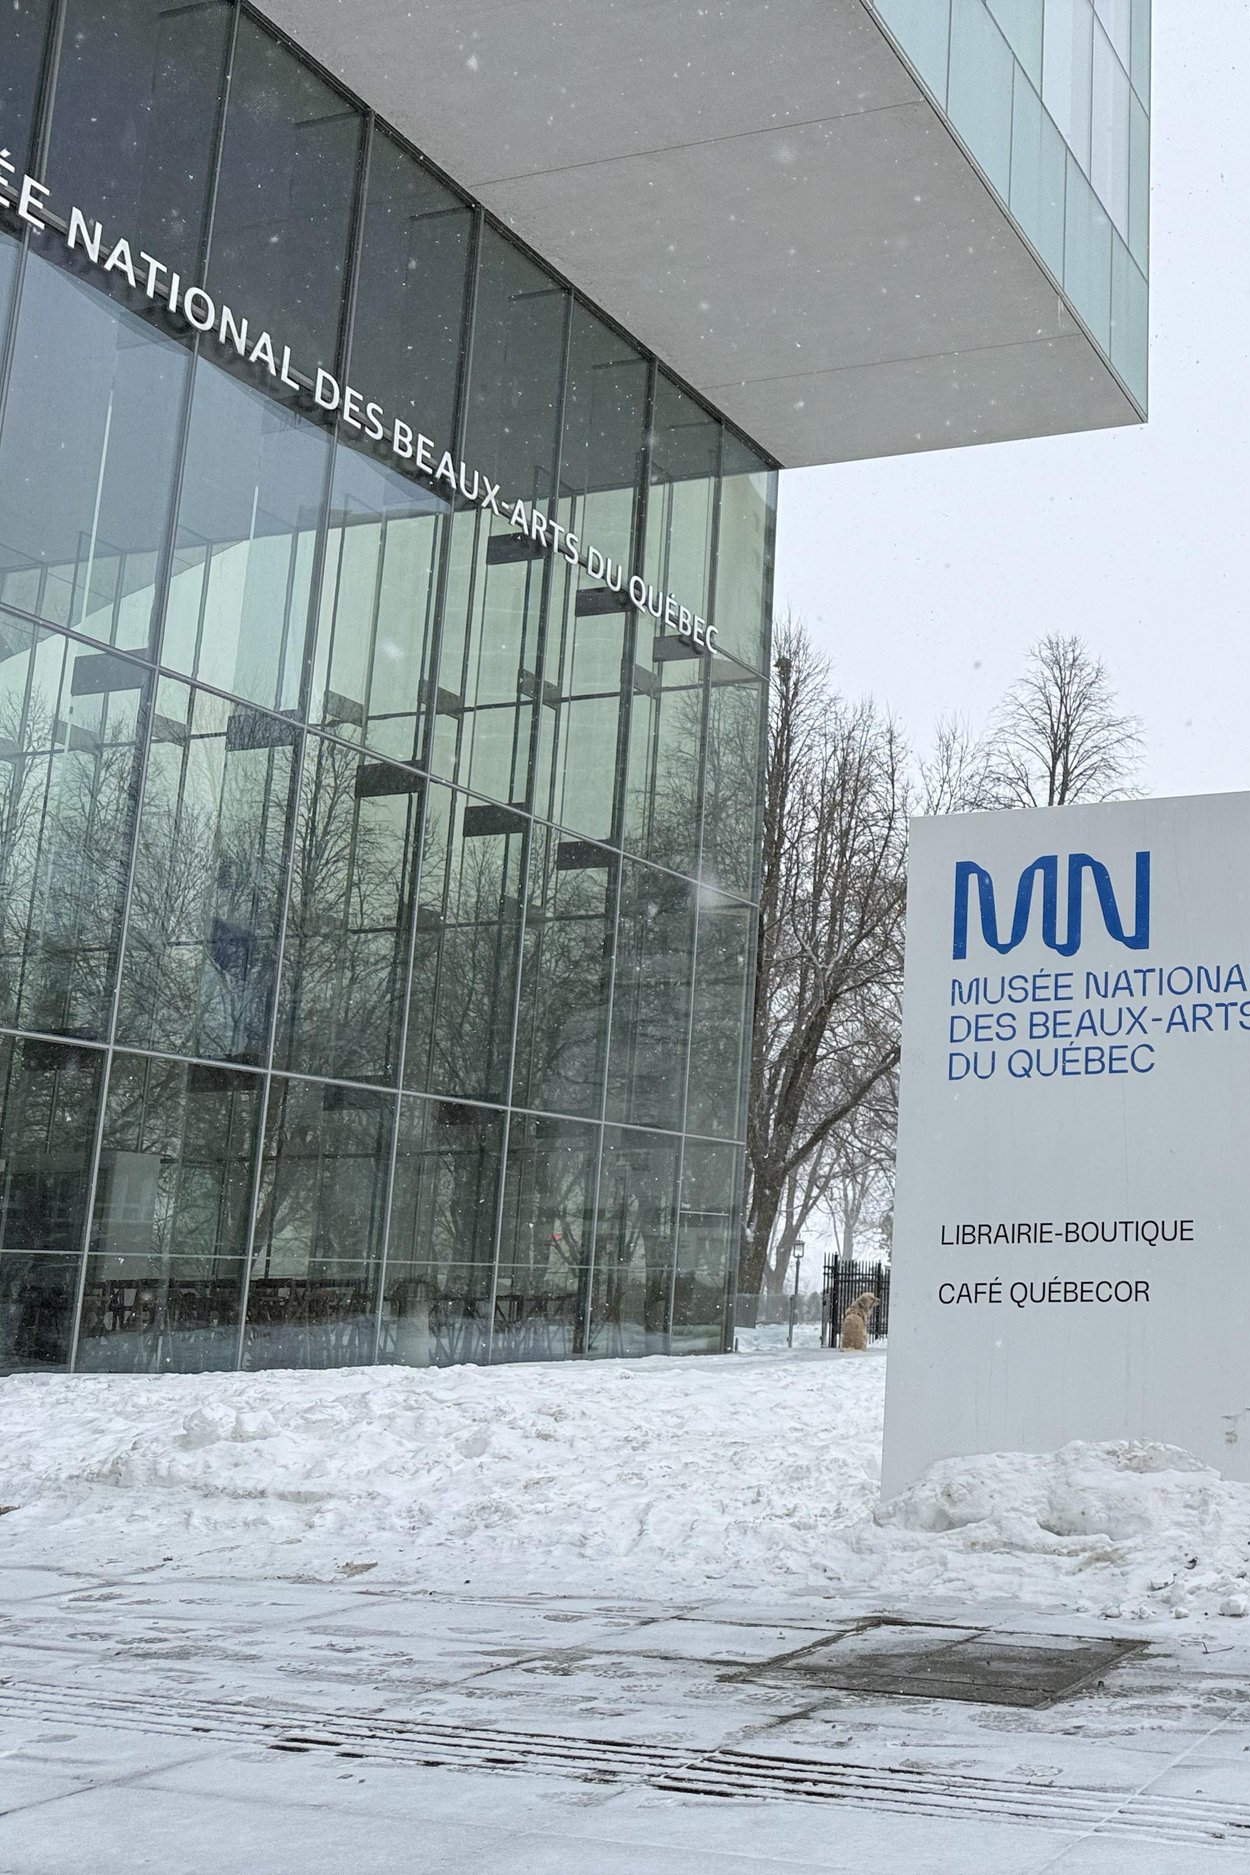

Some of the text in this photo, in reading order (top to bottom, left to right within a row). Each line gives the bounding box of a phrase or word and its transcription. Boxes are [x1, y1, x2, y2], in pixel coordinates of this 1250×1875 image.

[66, 206, 300, 391] NATIONAL
[314, 367, 384, 441] DES
[393, 418, 579, 565] BEAUX-ARTS
[587, 545, 622, 592] DU
[628, 575, 719, 654] QUÉBEC
[951, 968, 1074, 1006] MUSÉE
[949, 1012, 1017, 1043] DES
[948, 1041, 1155, 1081] DU QUÉBEC
[941, 1220, 1194, 1246] LIBRAIRIE-BOUTIQUE
[938, 1276, 1150, 1308] CAFÉ QUÉBECOR
